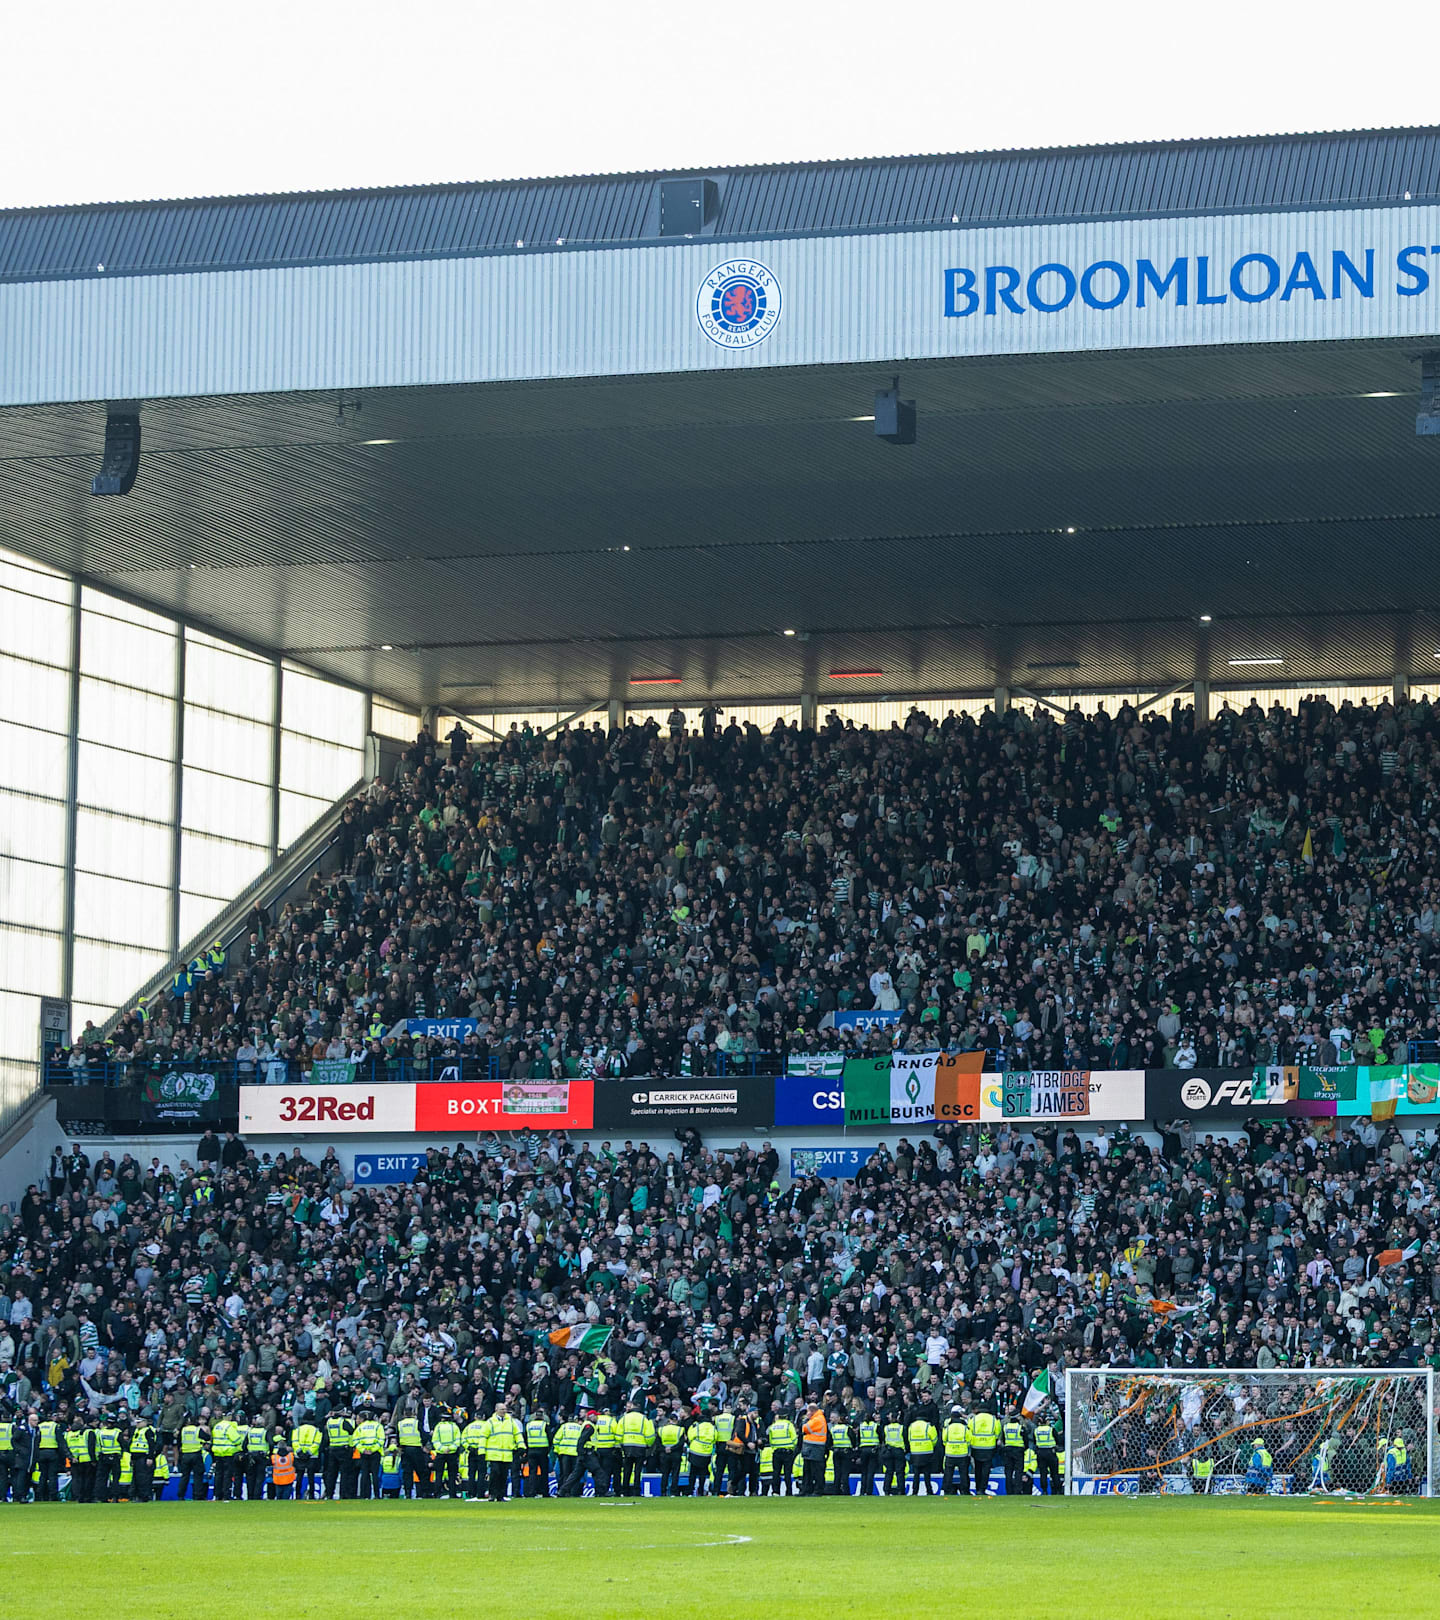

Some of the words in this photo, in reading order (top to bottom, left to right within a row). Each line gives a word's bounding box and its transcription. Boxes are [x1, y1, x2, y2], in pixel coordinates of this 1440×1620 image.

[706, 263, 772, 289] RANGERS
[943, 248, 1375, 317] BROOMLOAN
[702, 313, 753, 345] FOOTBALL
[754, 310, 776, 337] CLUB
[727, 325, 750, 333] READY
[427, 1025, 459, 1037] EXIT
[463, 1024, 473, 1036] 2
[856, 1017, 890, 1030] EXIT
[874, 1056, 957, 1071] GARNGAD
[654, 1093, 688, 1101] CARRICK
[690, 1092, 735, 1101] PACKAGING
[1187, 1085, 1206, 1096] EA
[279, 1095, 374, 1122] 32Red
[448, 1099, 502, 1115] BOXT
[1006, 1093, 1029, 1113] ST.
[1035, 1092, 1085, 1113] JAMES
[630, 1107, 657, 1115] Specialist
[664, 1107, 689, 1115] Injection
[711, 1106, 738, 1115] Moulding
[850, 1104, 935, 1121] MILLBURN
[942, 1104, 974, 1116] CSC
[377, 1157, 406, 1170] EXIT
[410, 1156, 420, 1169] 2
[815, 1151, 846, 1164] EXIT
[850, 1151, 859, 1163] 3
